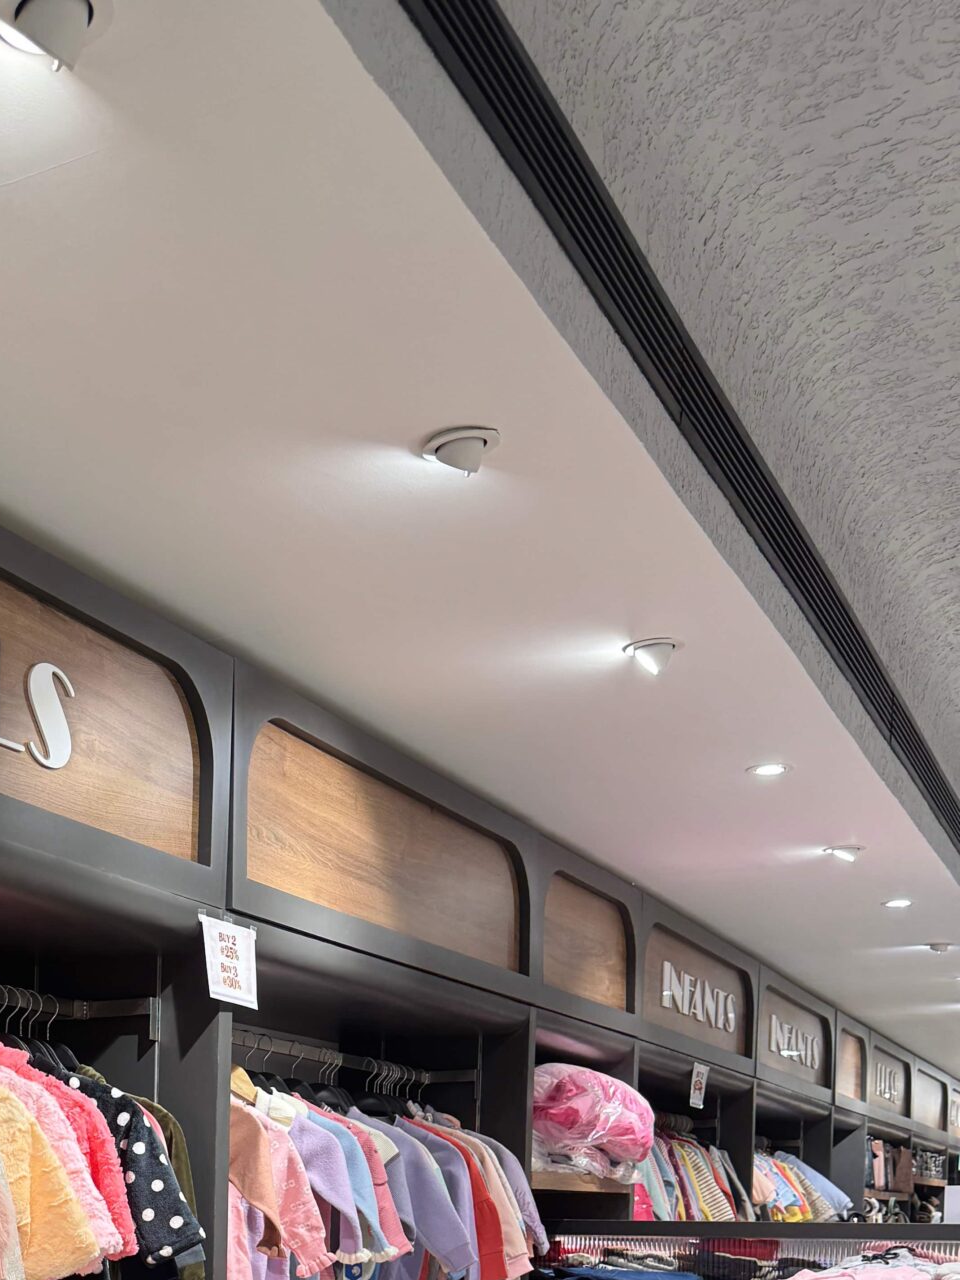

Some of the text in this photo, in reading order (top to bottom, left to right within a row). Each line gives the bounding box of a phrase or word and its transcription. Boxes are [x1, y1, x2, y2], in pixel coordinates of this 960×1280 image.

[218, 931, 237, 946] BUY 2
[220, 962, 239, 978] BUY 3
[661, 960, 736, 1033] INFANTS
[770, 1014, 819, 1070] INFANTS
